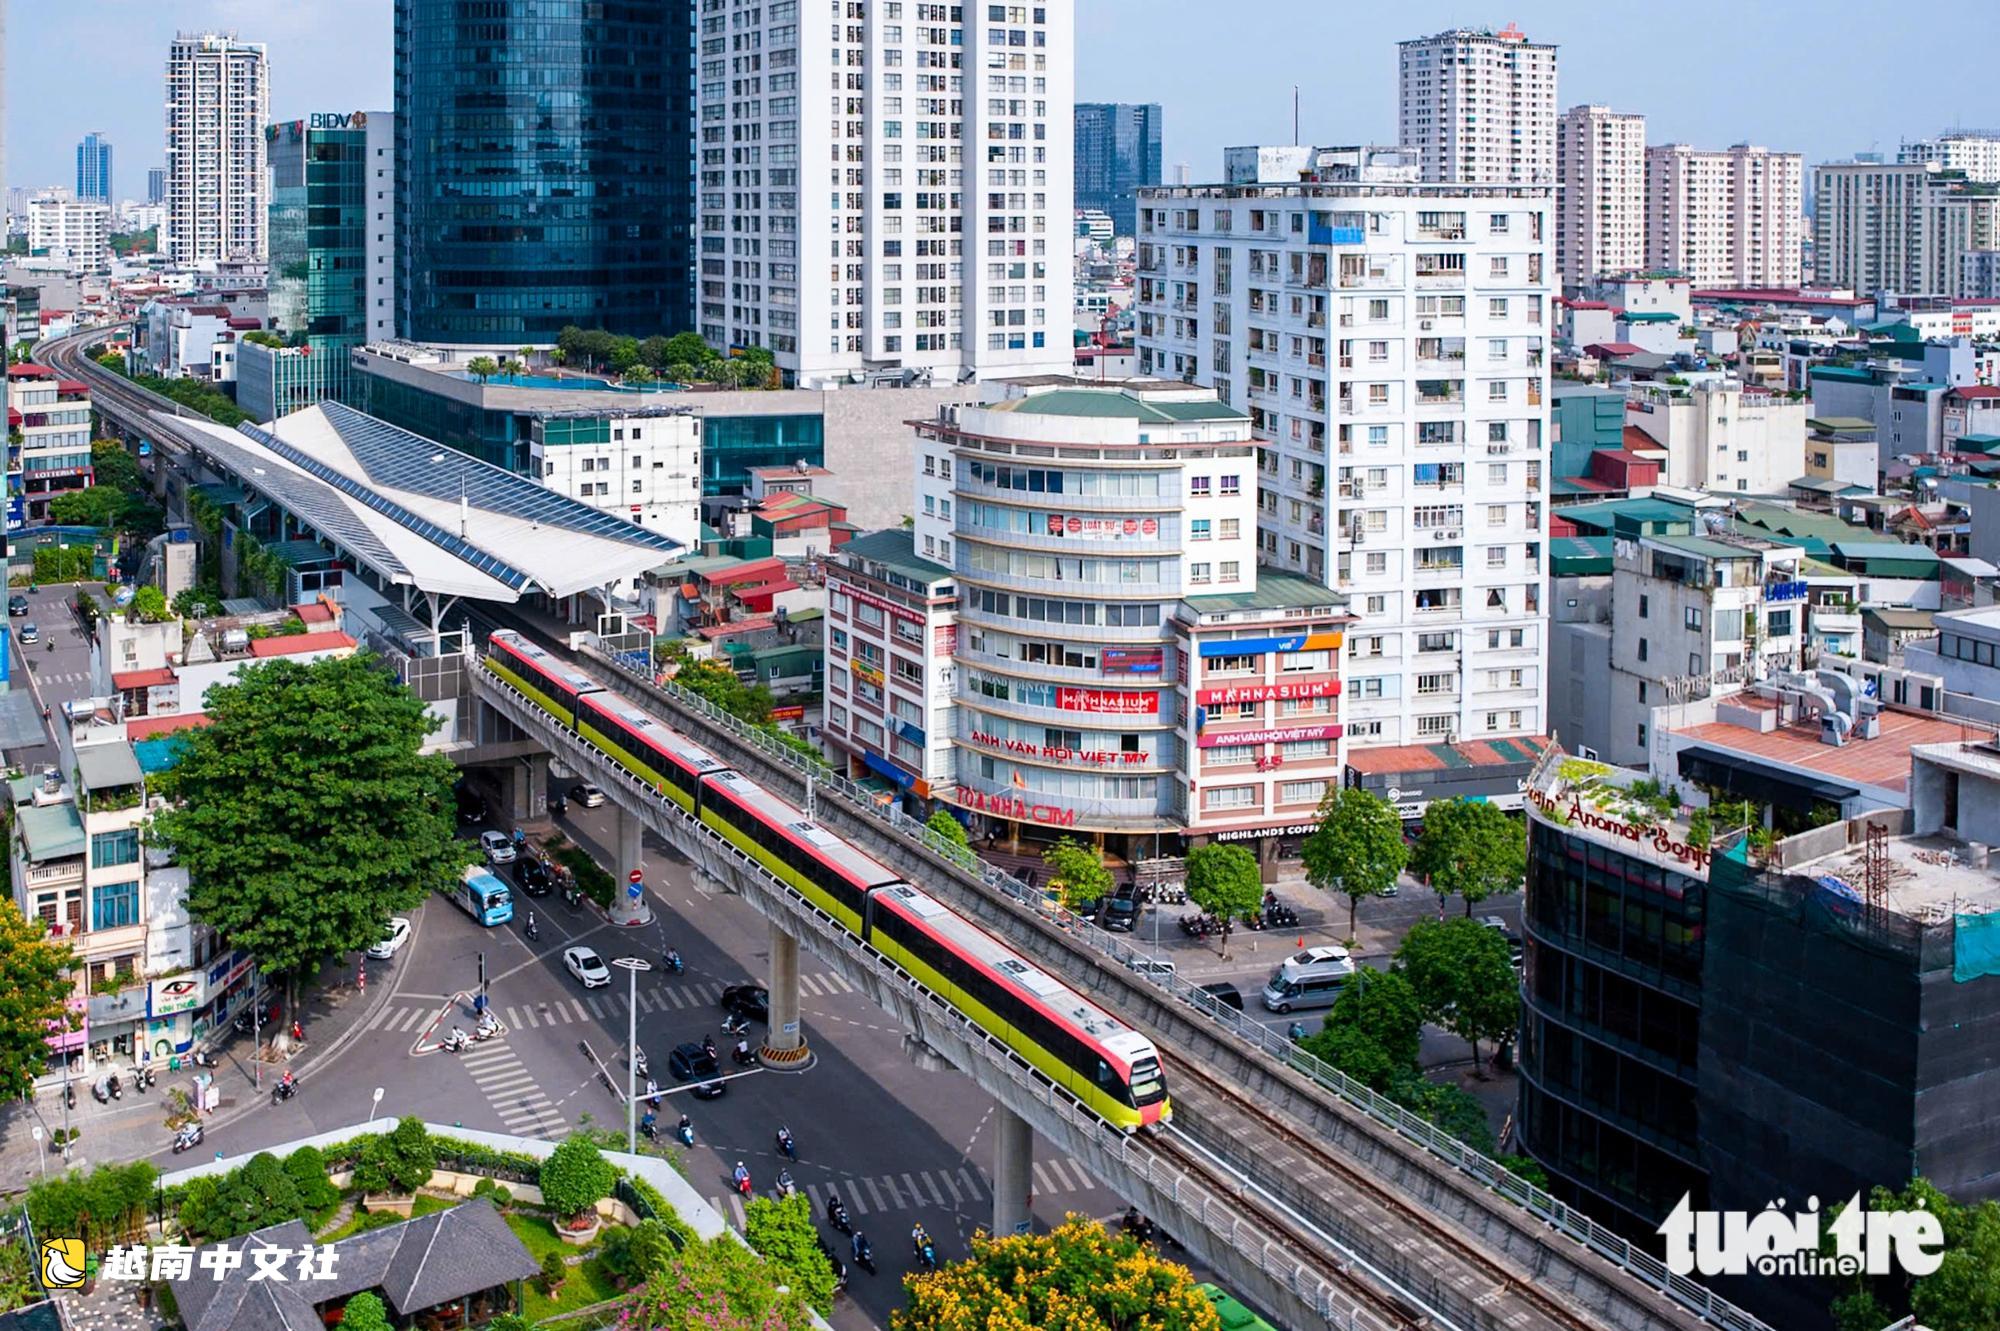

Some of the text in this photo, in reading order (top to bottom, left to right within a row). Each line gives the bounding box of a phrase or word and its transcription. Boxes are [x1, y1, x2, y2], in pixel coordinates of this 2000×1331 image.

[310, 113, 351, 128] BIDV
[280, 346, 301, 356] BIC
[35, 469, 75, 478] LOTTERIA
[1216, 727, 1325, 744] ANH VĂN HỘI VIỆT MỸ
[971, 730, 1149, 766] ANH VĂN HỘI VIỆT MỸ
[1218, 827, 1284, 841] HIGHLANDS
